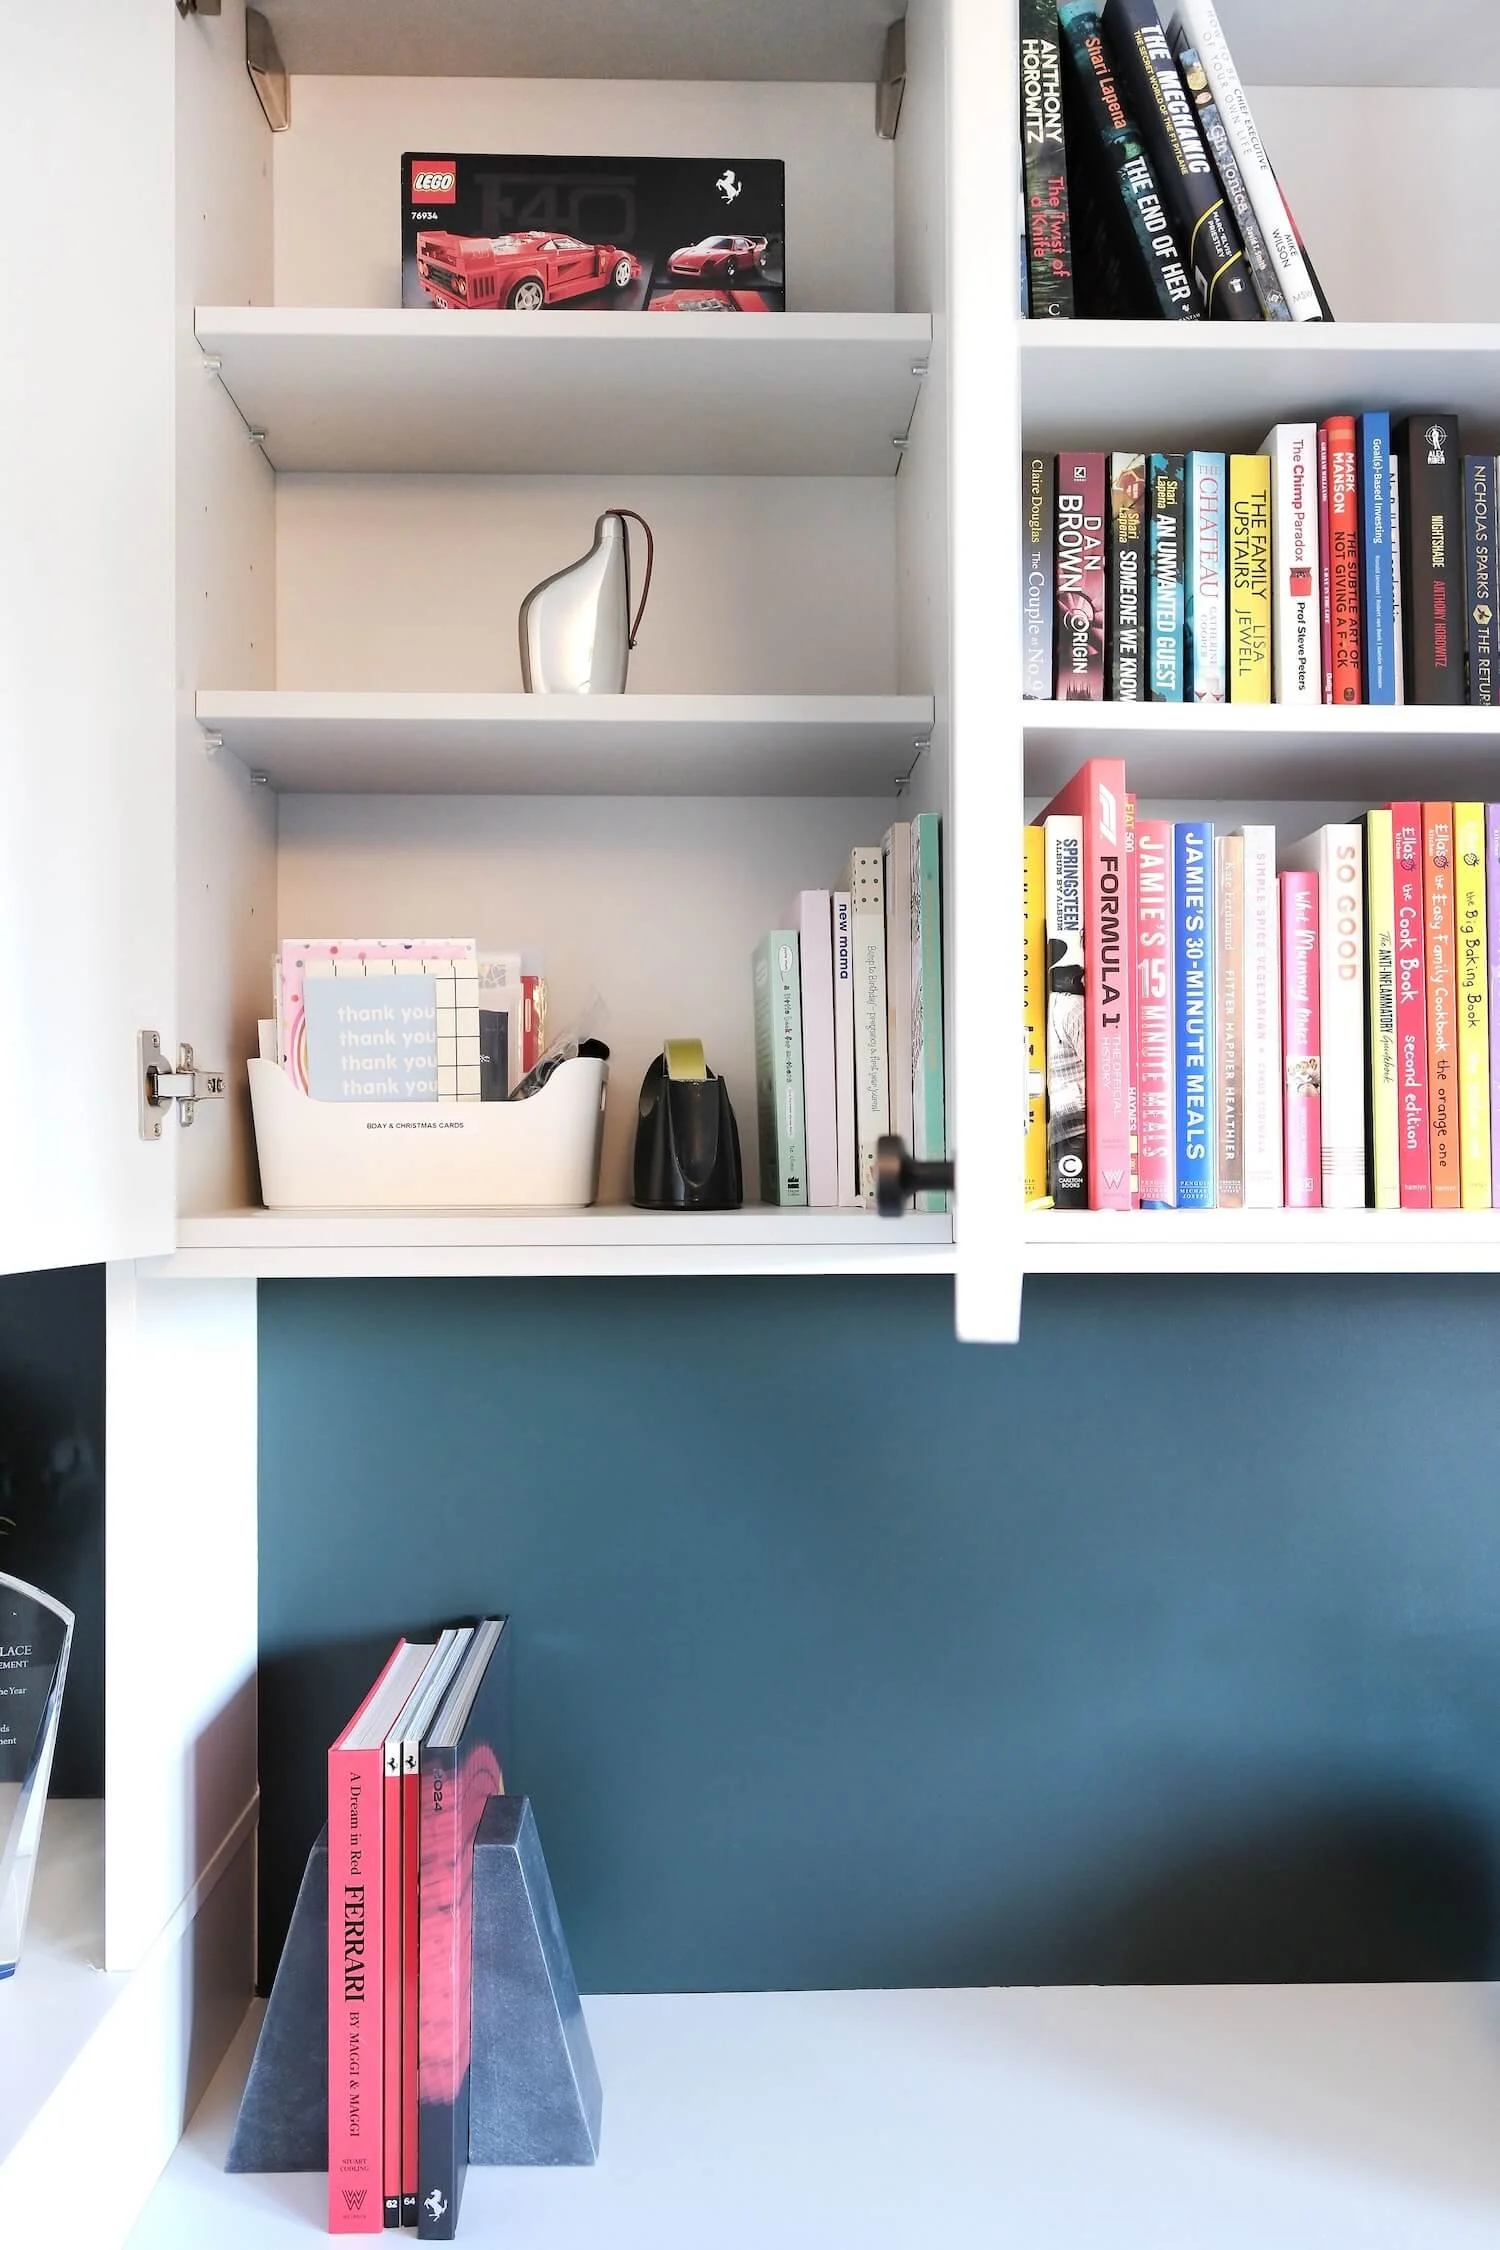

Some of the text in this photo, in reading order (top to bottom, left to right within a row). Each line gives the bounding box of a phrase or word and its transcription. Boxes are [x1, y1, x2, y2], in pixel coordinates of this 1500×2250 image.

[1022, 39, 1044, 144] HOROWITZ
[1040, 40, 1062, 144] ANTHONY
[1085, 36, 1127, 130] Shari Lapena
[1141, 25, 1211, 174] THE MECHANIC
[1211, 55, 1229, 88] YOUR
[1139, 46, 1189, 175] SECRET WORLD PITLANE
[1234, 88, 1268, 171] CHIEF EXECUTIVE
[413, 171, 455, 192] LEGO
[411, 211, 438, 221] 76934
[1030, 196, 1048, 258] a Knife
[1048, 175, 1071, 278] The Twist of
[1125, 156, 1191, 303] THE END OF HER
[1208, 220, 1225, 258] PRIESTLEY
[1271, 228, 1291, 268] WILSON
[1285, 233, 1298, 257] MIKE
[1048, 303, 1060, 316] C
[1030, 459, 1043, 543] Claire Douglas
[1156, 475, 1168, 509] Lapena
[1166, 480, 1178, 504] Shari
[1291, 439, 1306, 562] The Chimp Paradox
[1333, 452, 1345, 514] MANSON
[1344, 451, 1356, 493] MARK
[1372, 438, 1383, 544] Goal(s)-Based Investing
[1058, 494, 1083, 593] BROWN
[1083, 516, 1102, 570] DAN
[1118, 507, 1130, 544] Lapena
[1128, 512, 1140, 540] Shari
[1234, 501, 1250, 590] UPSTAIRS
[1251, 489, 1267, 600] THE FAMILY
[1431, 515, 1444, 568] NIGHTSHADE
[1474, 465, 1489, 599] NICHOLAS SPARKS
[1024, 551, 1046, 635] The Couple
[1119, 551, 1138, 626] SOMEONE
[1156, 514, 1178, 691] AN UNWANTED GUEST
[1334, 531, 1347, 627] NOT GIVING A
[1346, 531, 1359, 669] THE SUBTLE ART OF
[1070, 611, 1089, 674] ORIGIN
[1119, 630, 1138, 654] WE
[1235, 608, 1251, 677] JEWELL
[1252, 625, 1266, 663] LISA
[1296, 602, 1308, 691] Prof Steve Peters
[1433, 579, 1447, 668] ANTHONY HOROWITZ
[1478, 625, 1491, 654] THE
[1125, 803, 1134, 829] FIAT
[1401, 826, 1417, 862] Ella's
[1434, 823, 1450, 858] Ella's
[1063, 838, 1079, 932] SPRINGSTEEN
[1139, 835, 1165, 947] JAMIE'S
[1336, 846, 1357, 982] SO GOOD
[839, 903, 849, 980] new mama
[1101, 856, 1120, 1006] FORMULA
[1291, 890, 1316, 1002] What Mummy
[1400, 883, 1420, 1005] the Cook Book
[1461, 909, 1479, 934] Big
[866, 974, 878, 1005] Birthday
[1185, 832, 1206, 1161] JAMIE'S 30-MINUTE MEALS
[1379, 948, 1394, 1035] ANTI-INFLAMMATORY
[1462, 939, 1481, 988] Baking
[337, 1004, 435, 1024] thank you
[338, 1028, 436, 1049] thank you
[1141, 1004, 1168, 1082] MINUTE
[1430, 893, 1451, 1168] Easy Family Cookbook the orange one
[1466, 993, 1482, 1029] Book
[341, 1053, 437, 1072] thank you
[343, 1077, 437, 1097] thank you
[1102, 1035, 1112, 1089] HISTORY
[1225, 969, 1236, 1161] FITTER HAPPIER HEALTHIER
[1403, 1034, 1424, 1150] second edition
[1129, 1086, 1137, 1131] HAYNES
[1142, 1091, 1168, 1158] MEALS
[9, 1686, 27, 1696] Year
[433, 1768, 443, 1812] 2024
[344, 1771, 366, 2137] A Dream in Red FERRARI BY MAGGI & MAGGI
[385, 2199, 398, 2209] 62
[403, 2197, 416, 2206] 64
